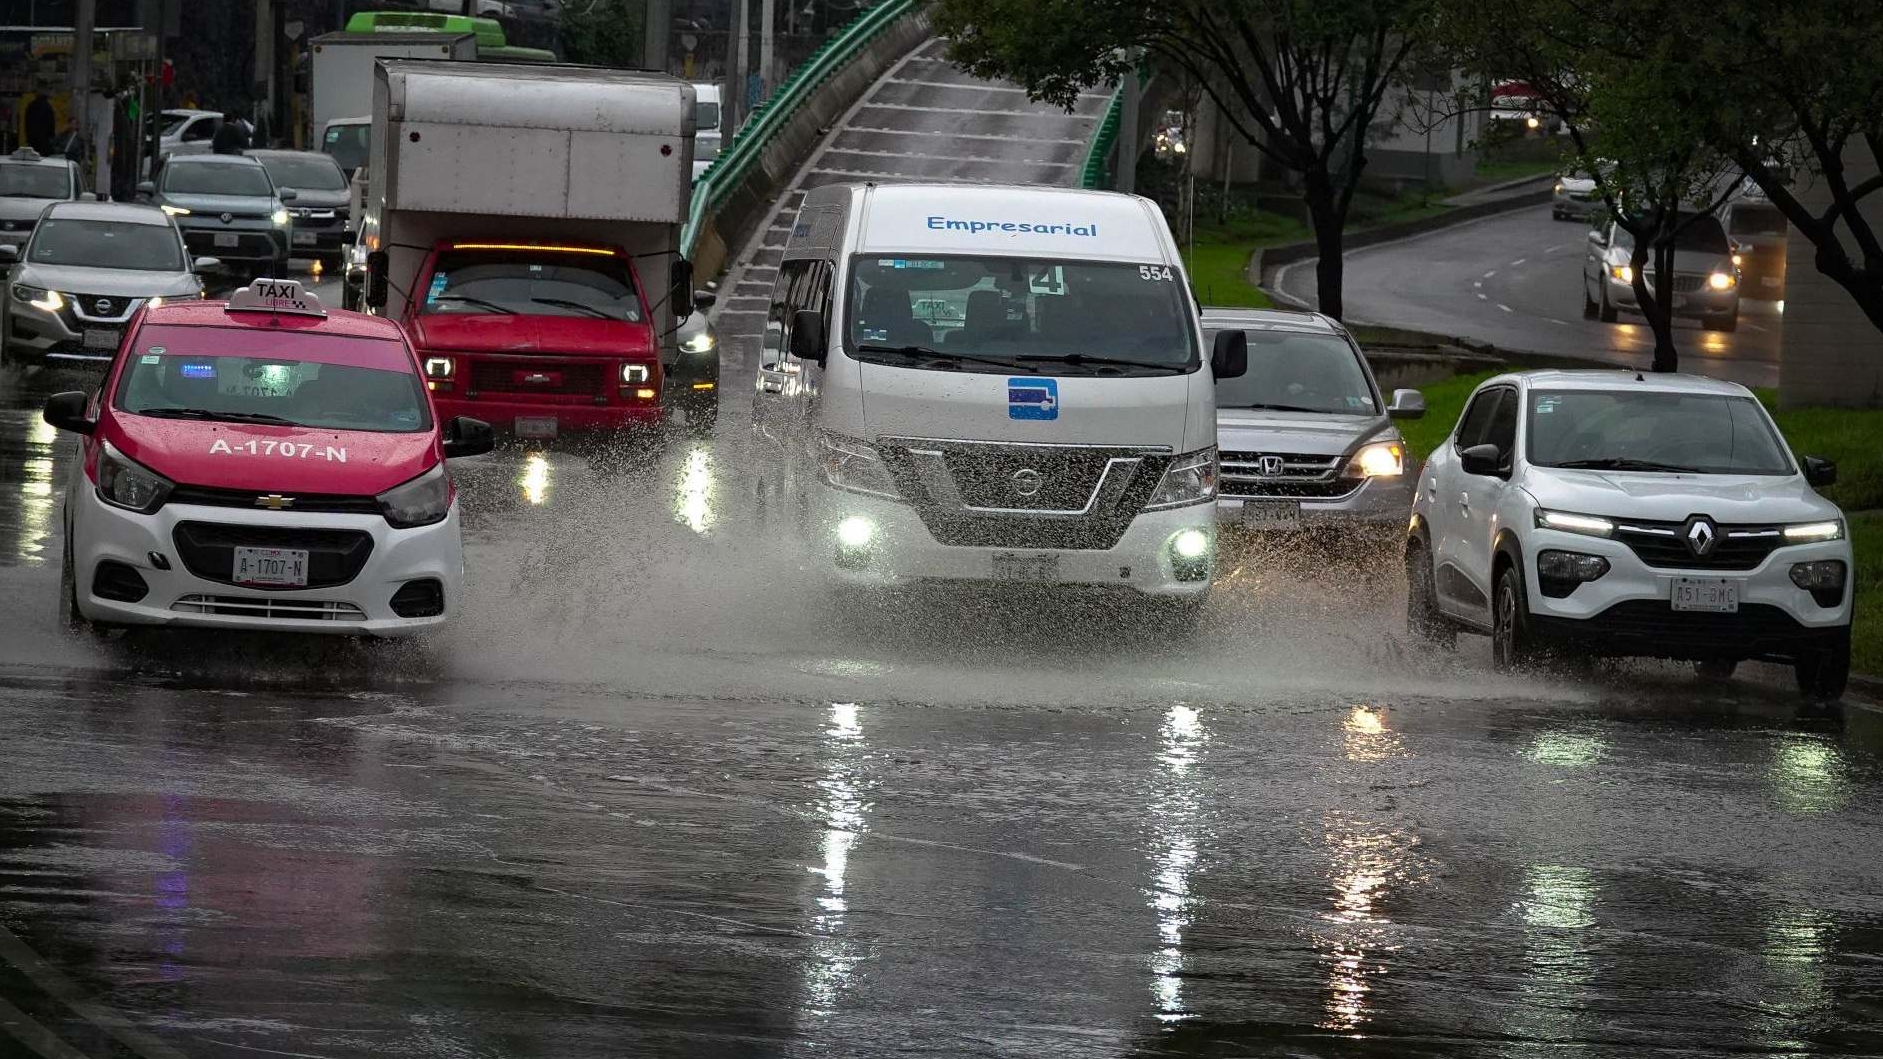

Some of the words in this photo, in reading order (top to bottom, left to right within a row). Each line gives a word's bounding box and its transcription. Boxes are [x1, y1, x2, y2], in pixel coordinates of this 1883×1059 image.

[926, 215, 1097, 237] Empresarial
[1031, 265, 1062, 293] 4
[1139, 265, 1173, 282] 554
[257, 283, 295, 299] TAXI
[265, 298, 291, 307] LIBRE
[209, 439, 347, 463] A-1707-N
[240, 557, 303, 577] A-1707-N
